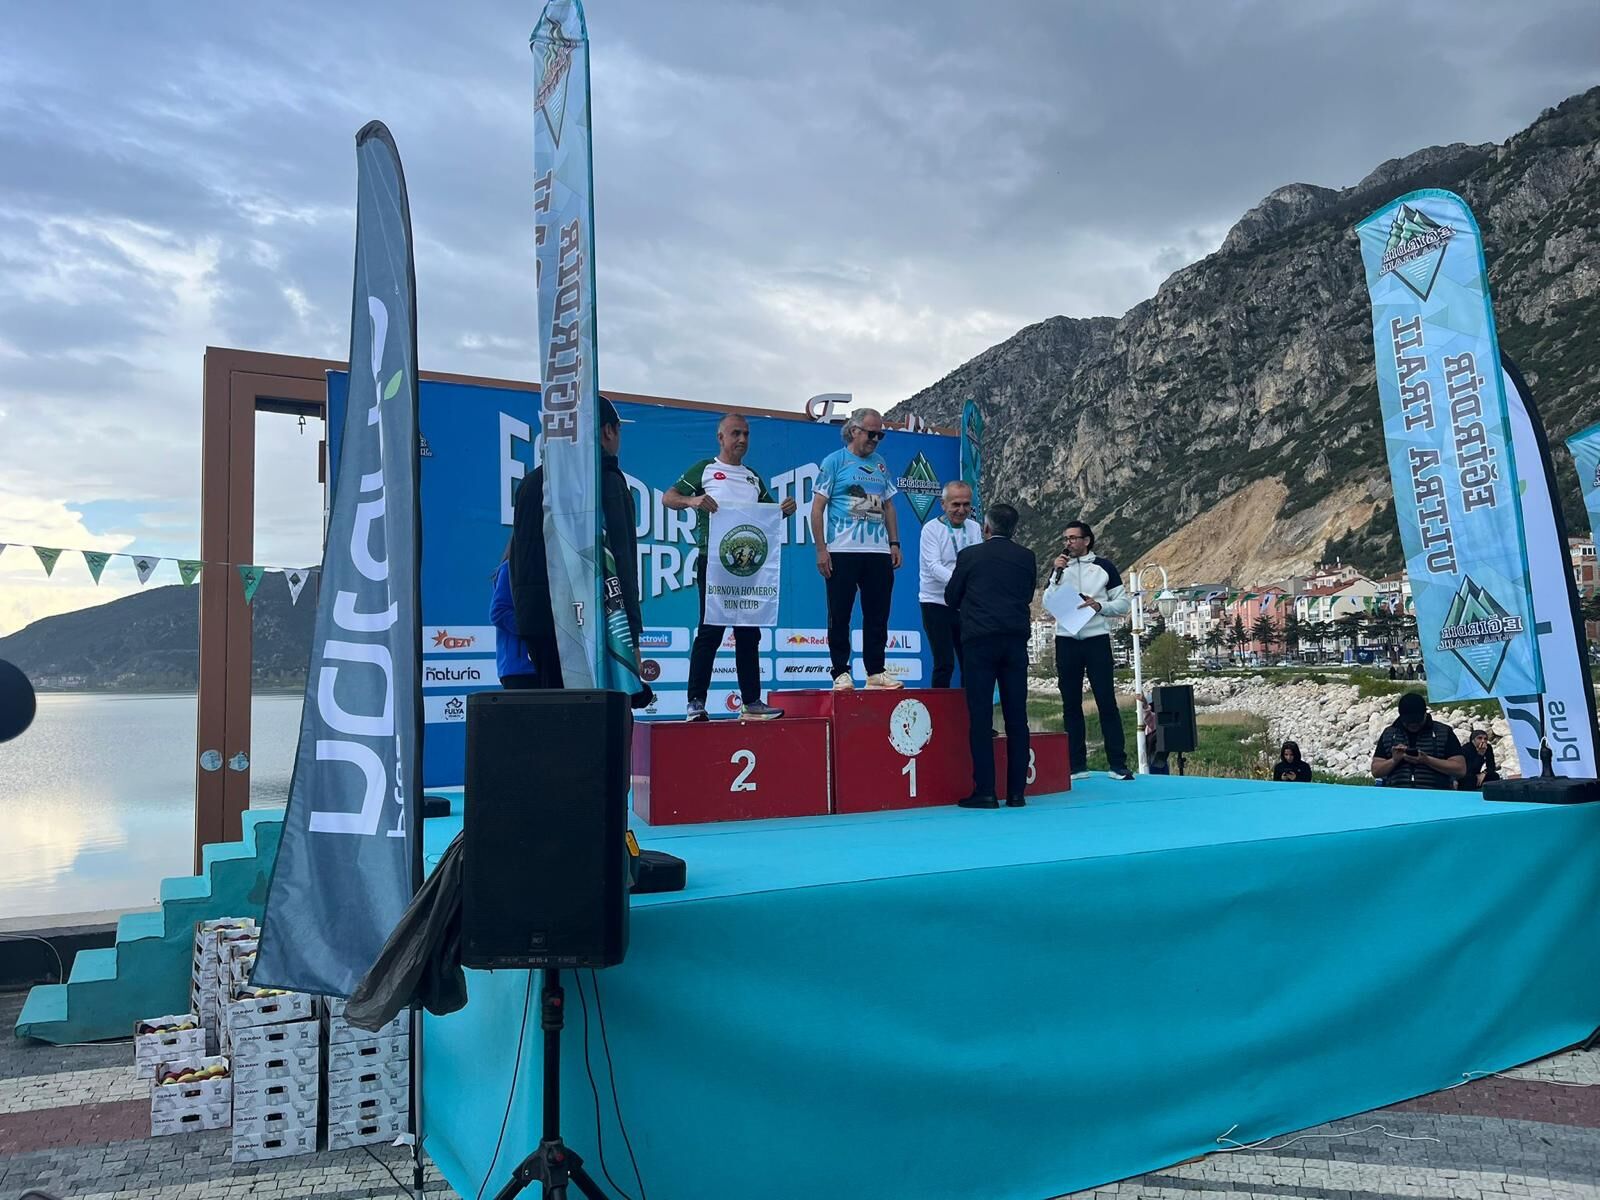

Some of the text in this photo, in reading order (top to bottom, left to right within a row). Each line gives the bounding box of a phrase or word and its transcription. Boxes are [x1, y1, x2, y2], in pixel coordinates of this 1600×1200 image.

[708, 585, 778, 596] BORNOVA HOMEROS
[724, 600, 759, 609] RUN CLUB
[811, 636, 825, 645] Red
[730, 749, 757, 792] 2
[902, 758, 917, 797] 1
